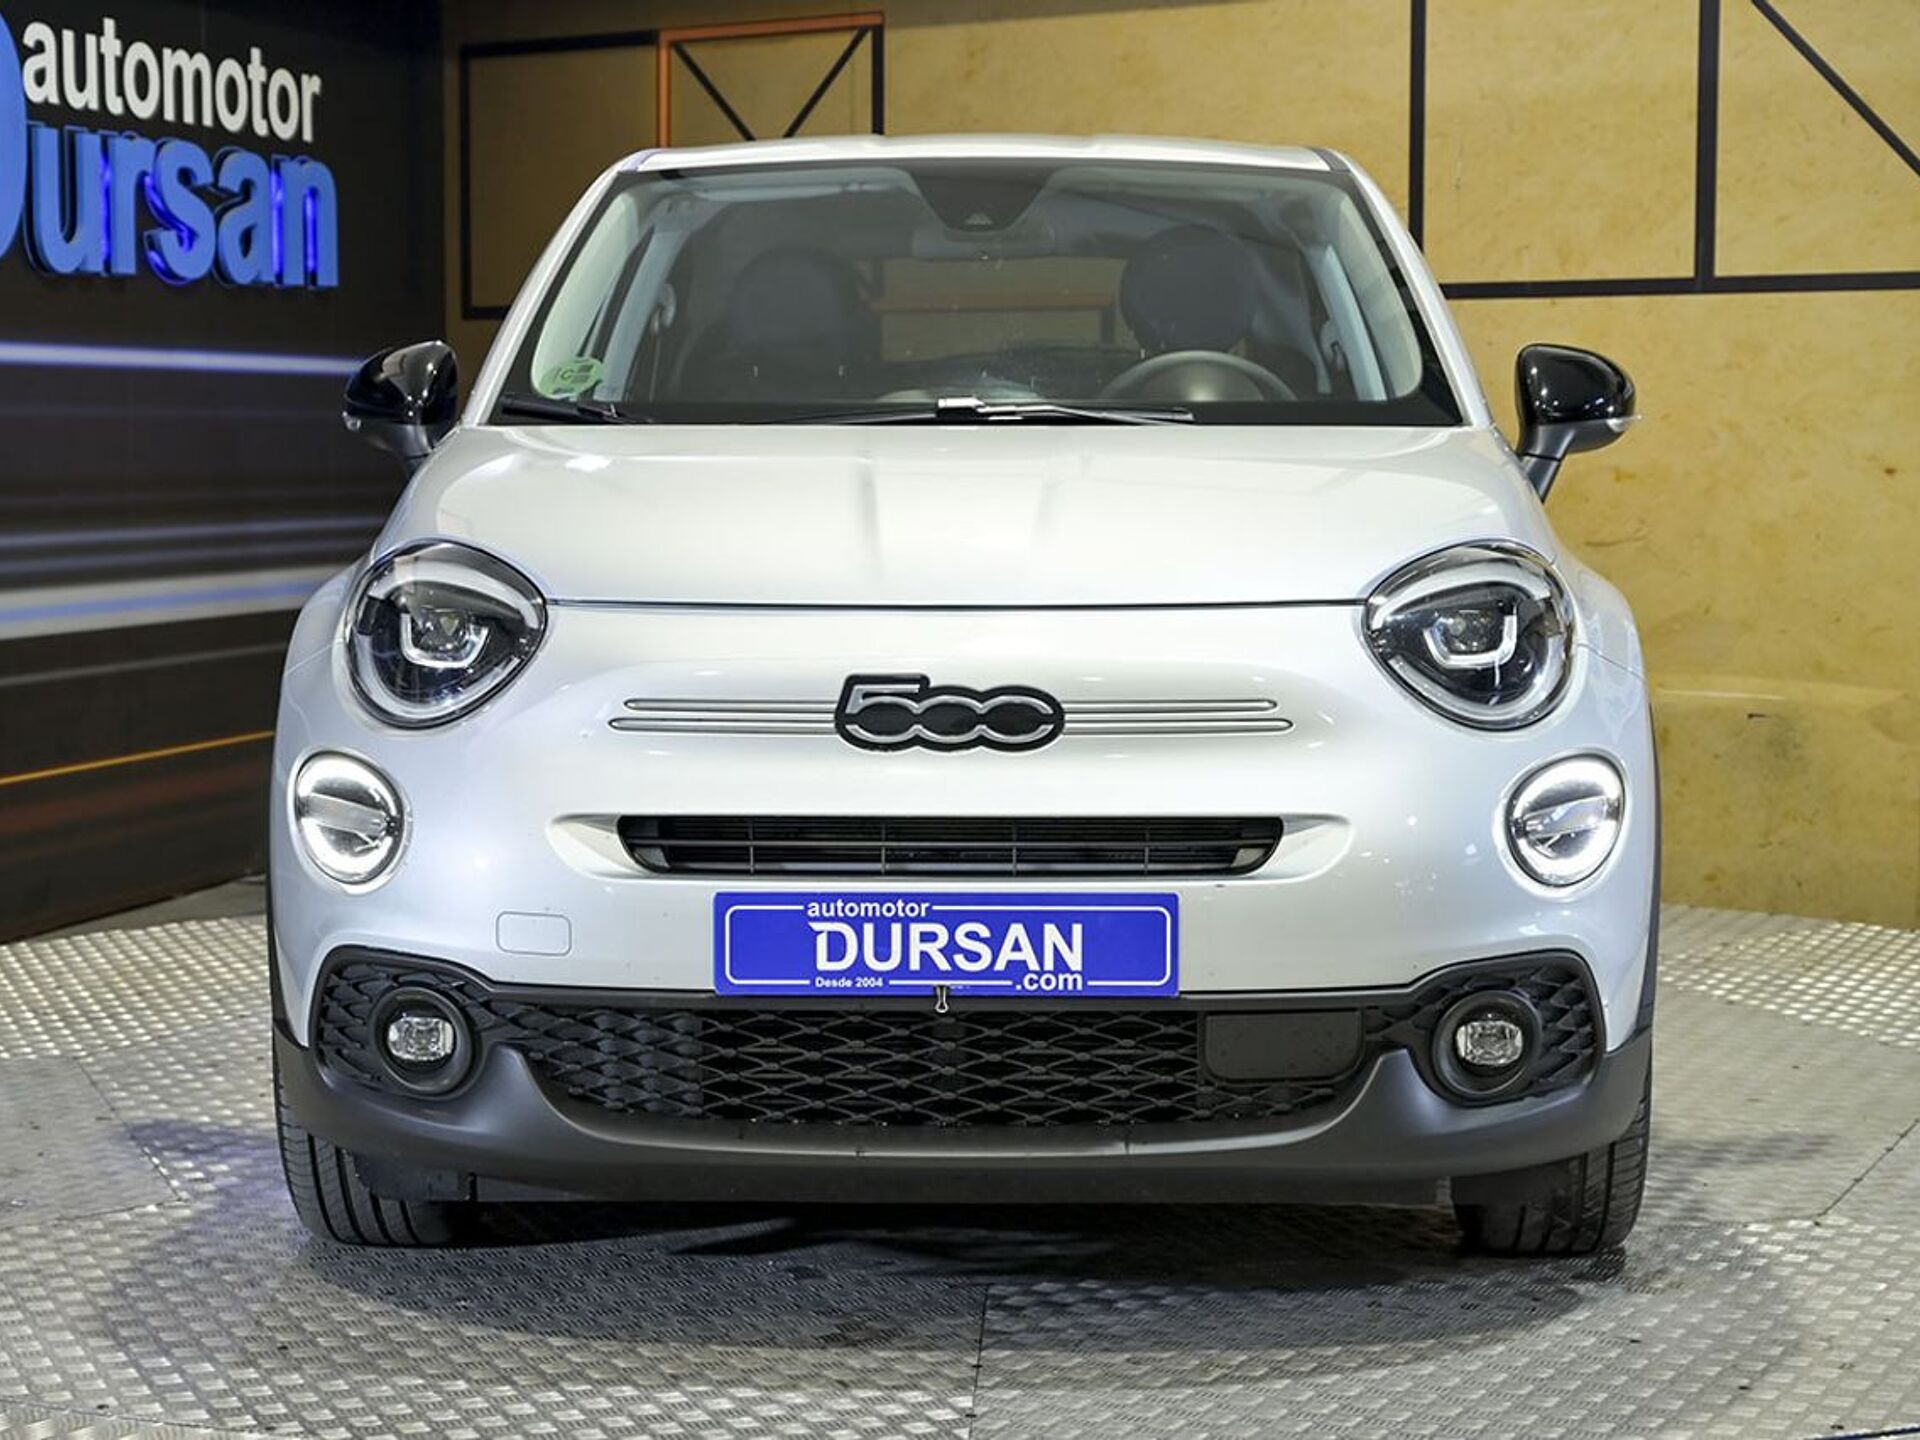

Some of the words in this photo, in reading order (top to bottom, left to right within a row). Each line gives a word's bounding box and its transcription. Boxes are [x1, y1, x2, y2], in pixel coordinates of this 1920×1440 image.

[22, 17, 321, 143] automotor
[835, 674, 1065, 752] 500
[807, 899, 930, 917] automotor
[808, 922, 1083, 972] DURSAN
[815, 977, 852, 988] Desde
[855, 977, 883, 988] 2004
[1016, 972, 1083, 991] .com
